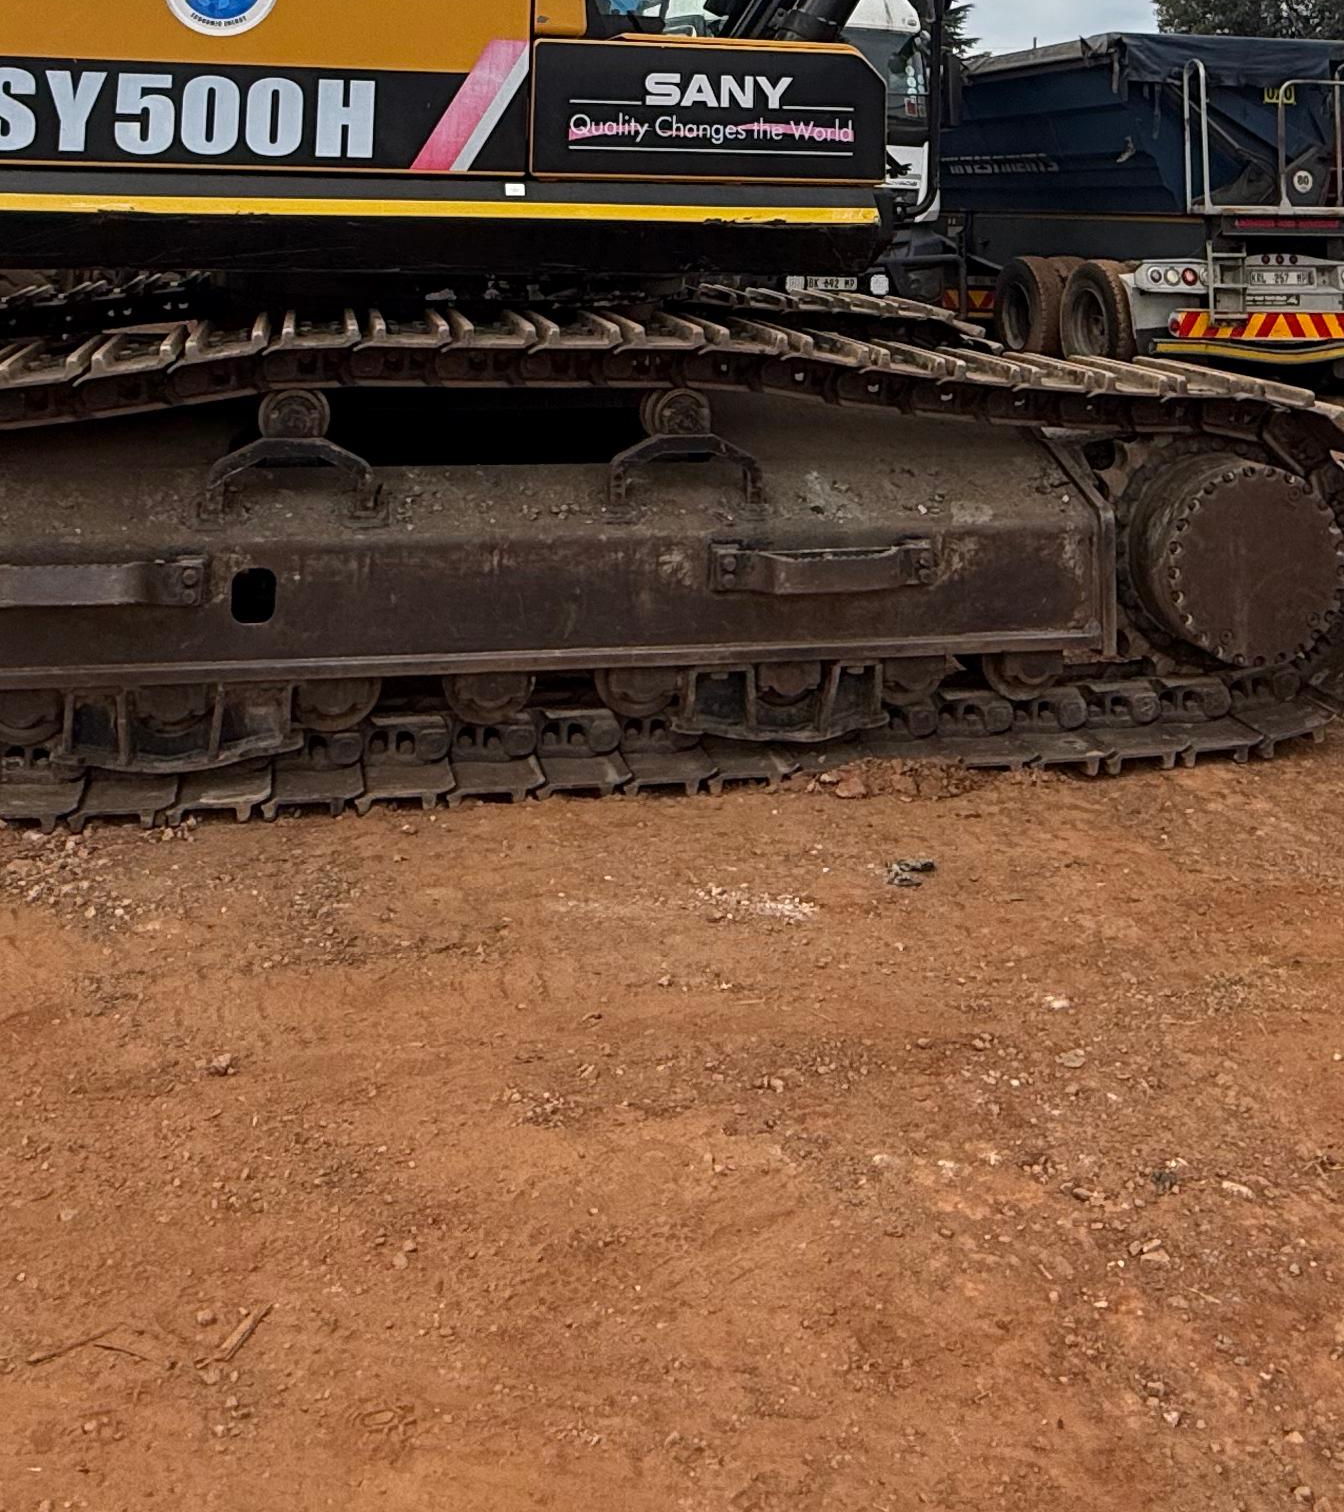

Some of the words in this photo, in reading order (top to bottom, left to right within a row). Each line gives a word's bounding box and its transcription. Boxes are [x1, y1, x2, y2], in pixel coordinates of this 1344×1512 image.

[645, 72, 793, 109] SANY
[570, 113, 650, 142] Quality
[656, 115, 745, 144] Changes
[753, 117, 784, 140] the
[791, 119, 854, 142] World
[1297, 175, 1309, 186] 80
